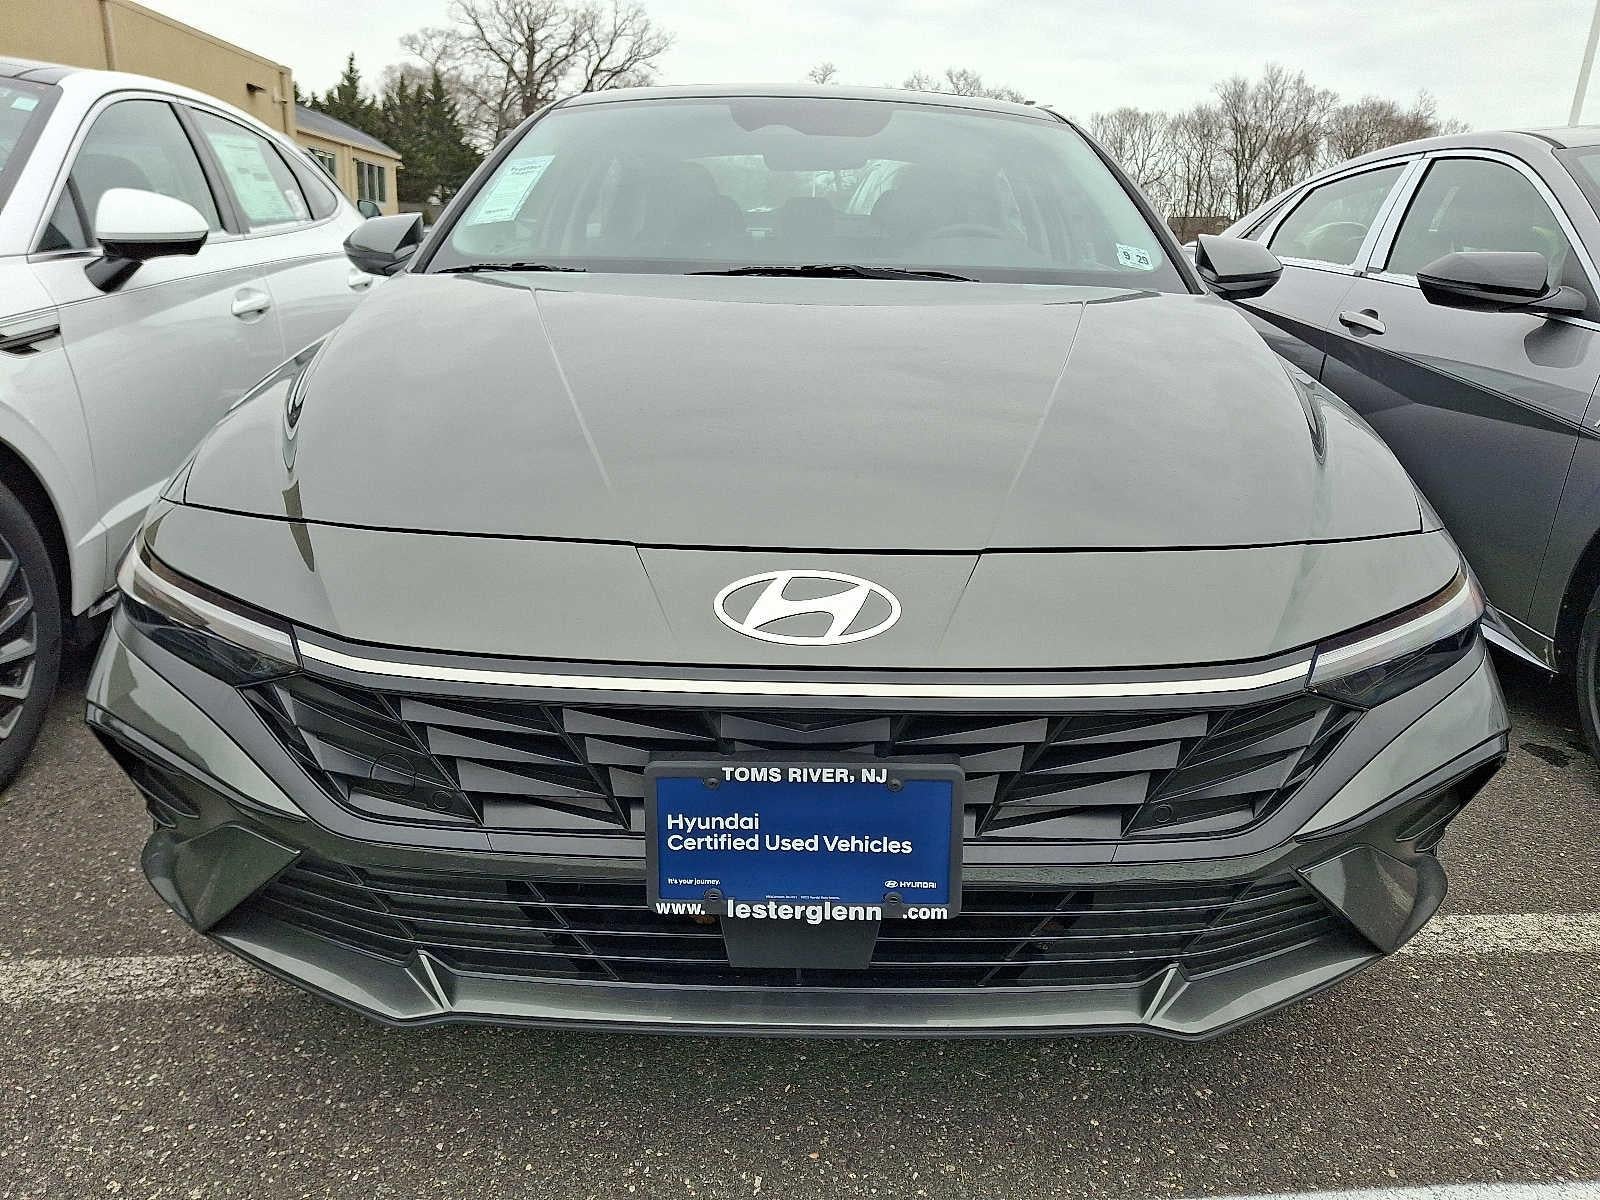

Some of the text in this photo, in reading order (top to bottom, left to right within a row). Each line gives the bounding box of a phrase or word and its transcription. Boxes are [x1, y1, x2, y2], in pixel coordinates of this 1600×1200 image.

[722, 767, 888, 784] TOMS RIVER, NJ
[667, 813, 760, 833] Hyundai
[667, 834, 913, 854] Certified Used Vehicles
[694, 877, 721, 886] journey.
[899, 881, 937, 889] HYUNDAI
[656, 899, 948, 925] www. lesterglenn .com
